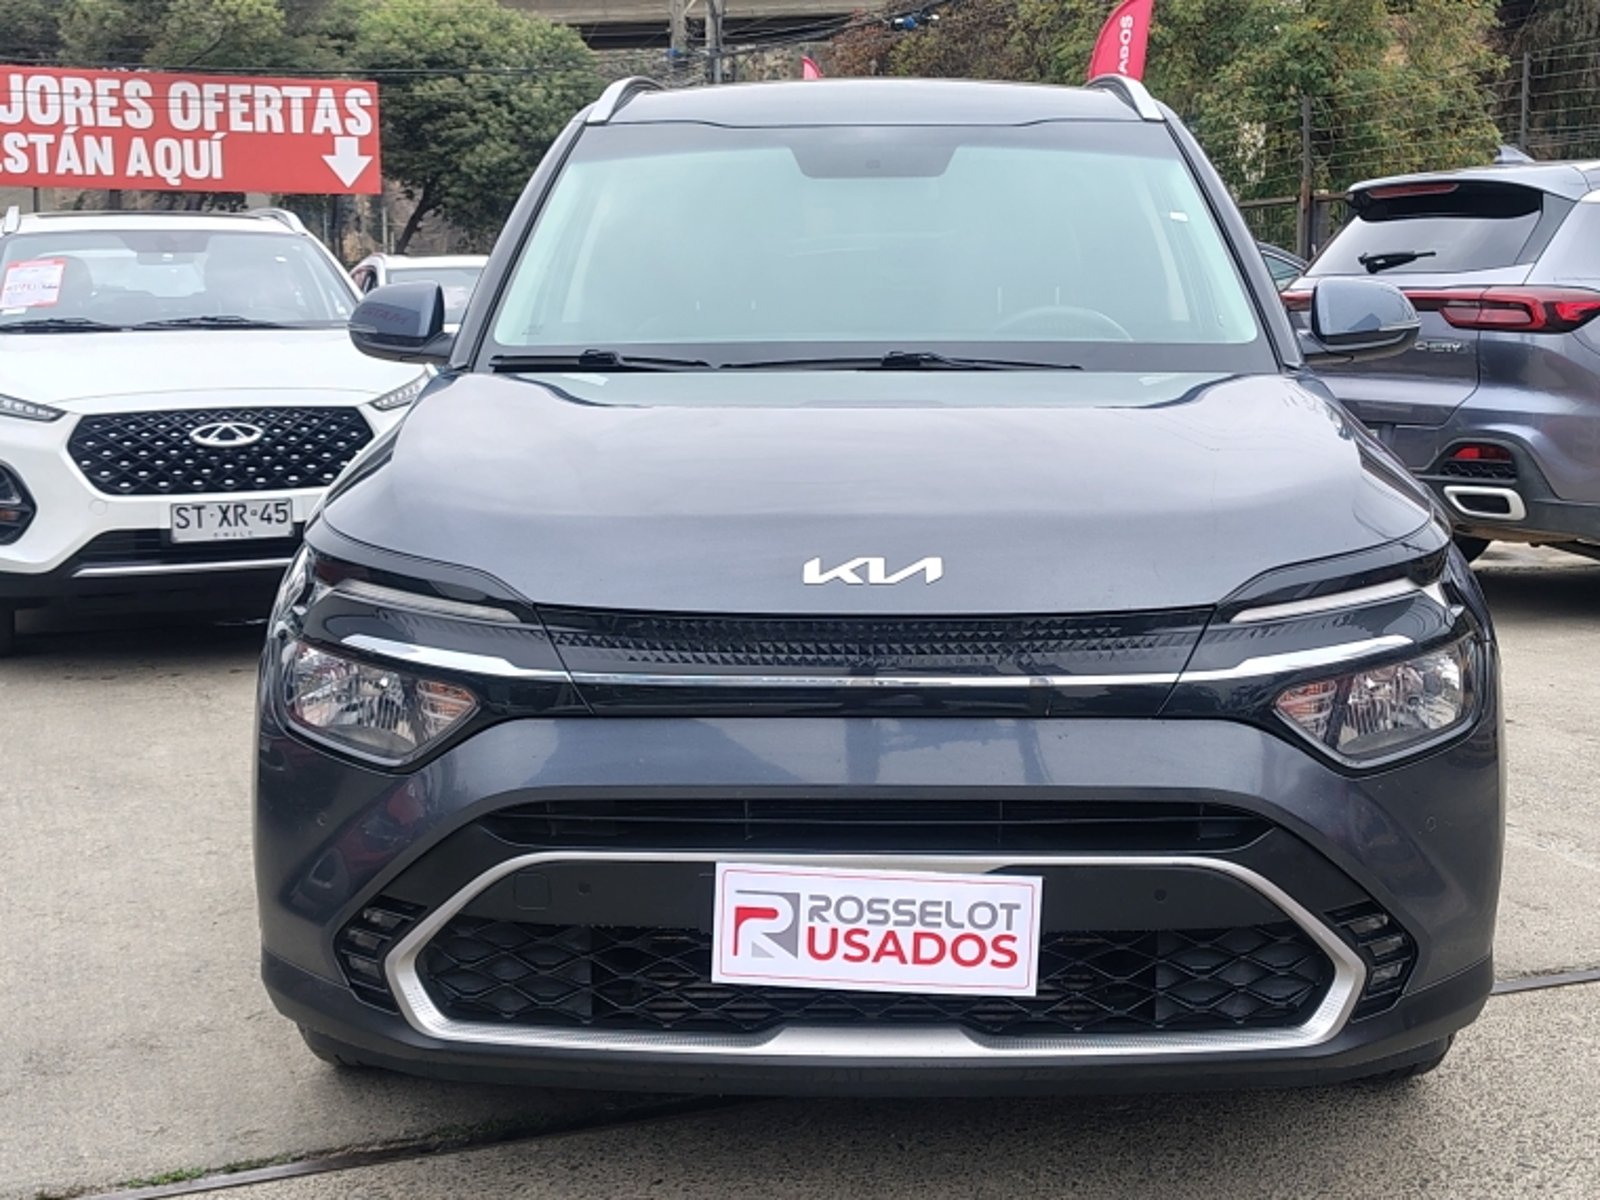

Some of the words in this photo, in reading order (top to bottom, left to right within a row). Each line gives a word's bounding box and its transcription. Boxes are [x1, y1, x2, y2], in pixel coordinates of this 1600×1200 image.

[0, 73, 154, 130] JORES
[168, 81, 373, 136] OFERTAS
[0, 125, 115, 176] STÁN
[126, 132, 227, 186] AQUÍ
[803, 556, 944, 585] KIA
[808, 894, 1021, 931] ROSSELOT
[807, 926, 1018, 969] USADOS
